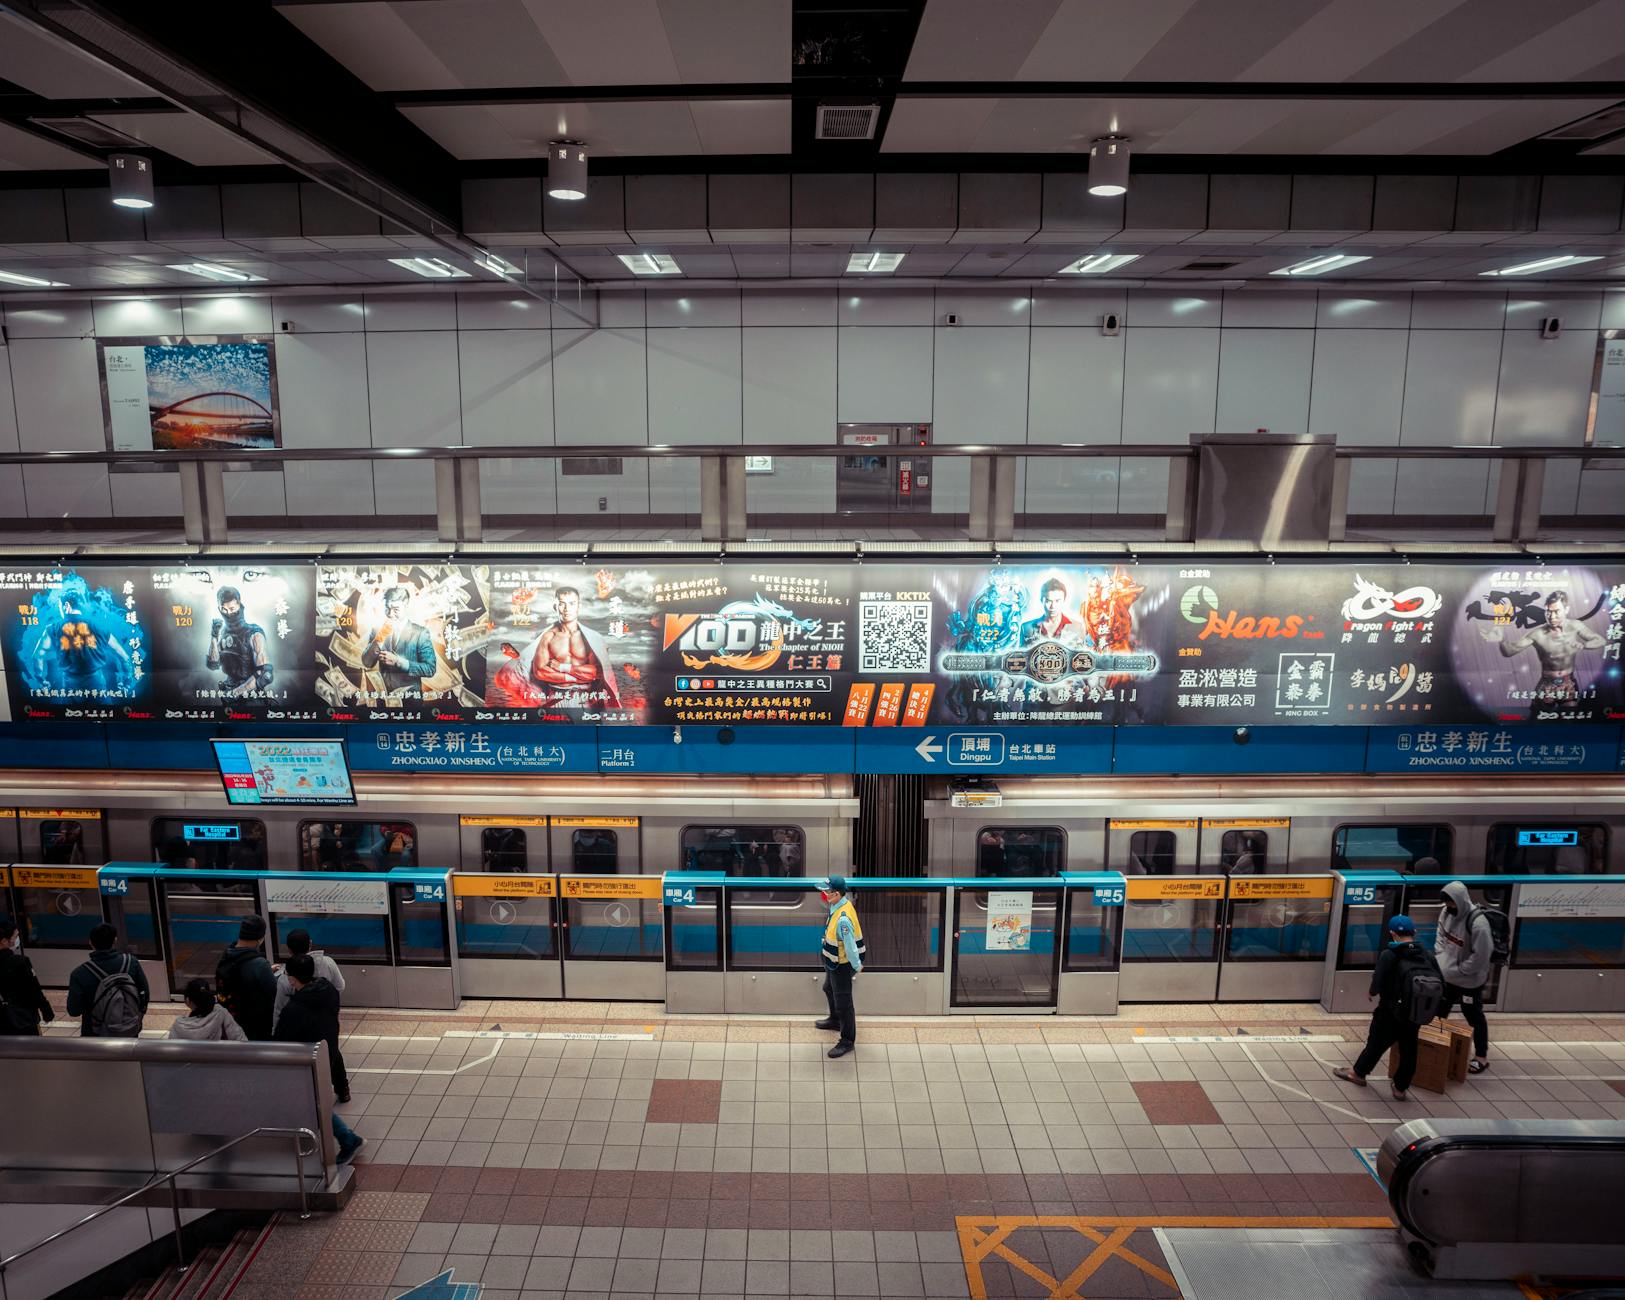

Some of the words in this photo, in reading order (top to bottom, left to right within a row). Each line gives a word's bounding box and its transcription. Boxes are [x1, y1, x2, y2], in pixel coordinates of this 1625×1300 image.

[896, 591, 931, 601] KKTIX
[175, 617, 193, 627] 120
[1198, 610, 1304, 641] Hans
[1415, 621, 1434, 631] Art
[759, 620, 846, 641] 龍中之王
[759, 643, 776, 651] The
[777, 643, 810, 653] Chapter
[811, 643, 821, 651] of
[822, 643, 844, 651] NIOH
[1178, 668, 1258, 688] 盈淞營造
[1177, 694, 1256, 707] 事業有限公司
[394, 731, 492, 753] 忠孝新生
[961, 737, 990, 752] 頂埔
[1414, 731, 1513, 753] 忠孝新生
[601, 749, 634, 760] 二月台
[1009, 744, 1056, 754] 台北車站
[391, 756, 448, 765] ZHONGXIAO
[450, 756, 496, 766] XINSHENG
[960, 753, 992, 763] Dingpu
[1009, 754, 1024, 762] Taipei
[1409, 757, 1466, 766] ZHONGXIAO
[1469, 757, 1514, 766] XINSHENG
[117, 879, 128, 893] 4
[432, 885, 444, 900] 4
[683, 889, 695, 903] 4
[1112, 889, 1124, 904] 5
[1363, 887, 1375, 901] 5
